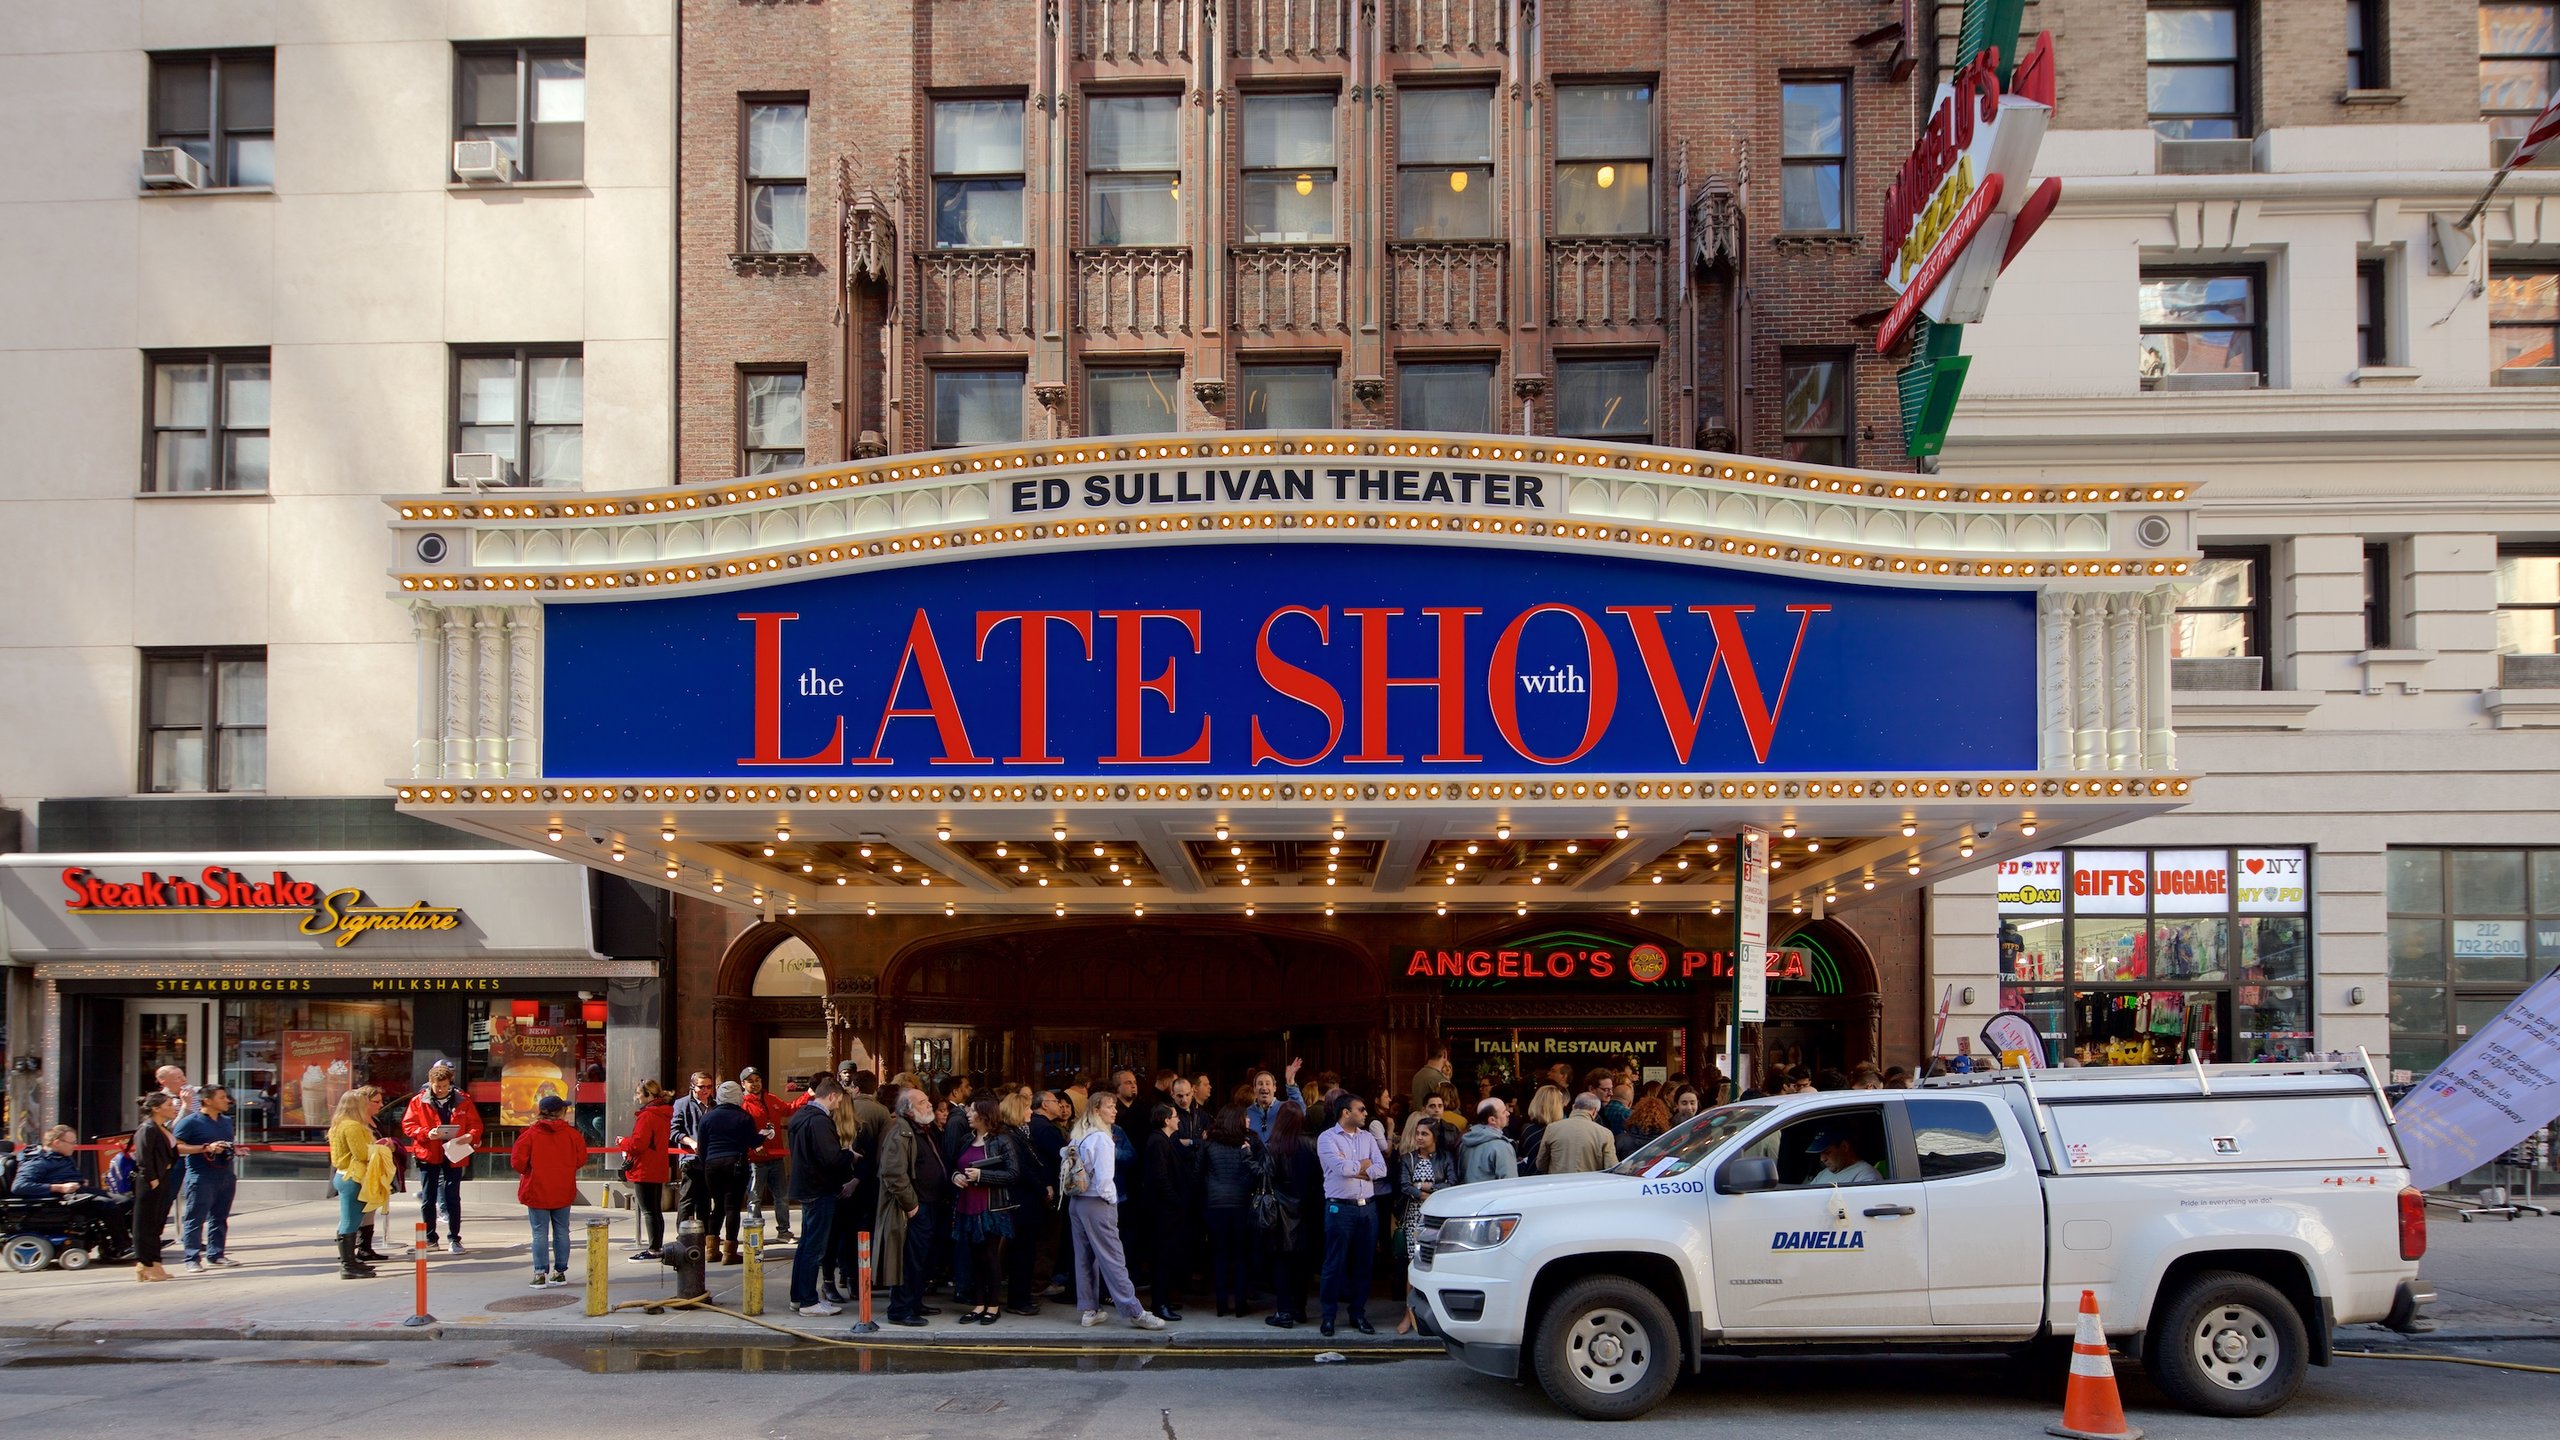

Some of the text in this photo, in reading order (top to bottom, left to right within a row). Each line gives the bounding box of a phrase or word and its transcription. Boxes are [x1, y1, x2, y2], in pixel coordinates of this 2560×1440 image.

[1881, 45, 2000, 281] ANGELO'S
[1900, 153, 1974, 284] PIZZA
[1879, 182, 1988, 348] ITALIAN RESTAURANT
[1011, 468, 1545, 513] ED SULLIVAN THEATER
[736, 602, 1832, 767] the LATE SHOW with
[1745, 865, 1751, 880] 3
[62, 866, 166, 908] Steak
[201, 865, 317, 908] Shake
[2074, 869, 2145, 896] GIFTS
[2153, 869, 2226, 895] LUGGAGE
[299, 887, 461, 948] Signature
[2477, 923, 2500, 936] 212
[1742, 946, 1748, 959] 6
[2457, 940, 2520, 953] 792.2600
[1406, 950, 1614, 977] ANGELO'S
[1632, 953, 1662, 963] COAL
[778, 958, 815, 974] 1697
[1633, 963, 1662, 973] OVEN
[156, 979, 501, 991] STEAKBURGERS MILKSHAKES
[2516, 1005, 2535, 1020] The
[528, 1028, 551, 1036] NEW!
[514, 1035, 565, 1047] CHEDDAR
[1474, 1038, 1657, 1053] ITALIAN RESTAURANT
[522, 1043, 560, 1058] Cheesy
[2507, 1051, 2558, 1086] Broadway
[2467, 1069, 2512, 1100] Follow Us
[1642, 1181, 1705, 1196] A1530D
[2180, 1199, 2199, 1207] Pride
[2209, 1198, 2247, 1207] everything
[1771, 1230, 1865, 1249] DANELLA
[1729, 1278, 1783, 1286] COLORADO
